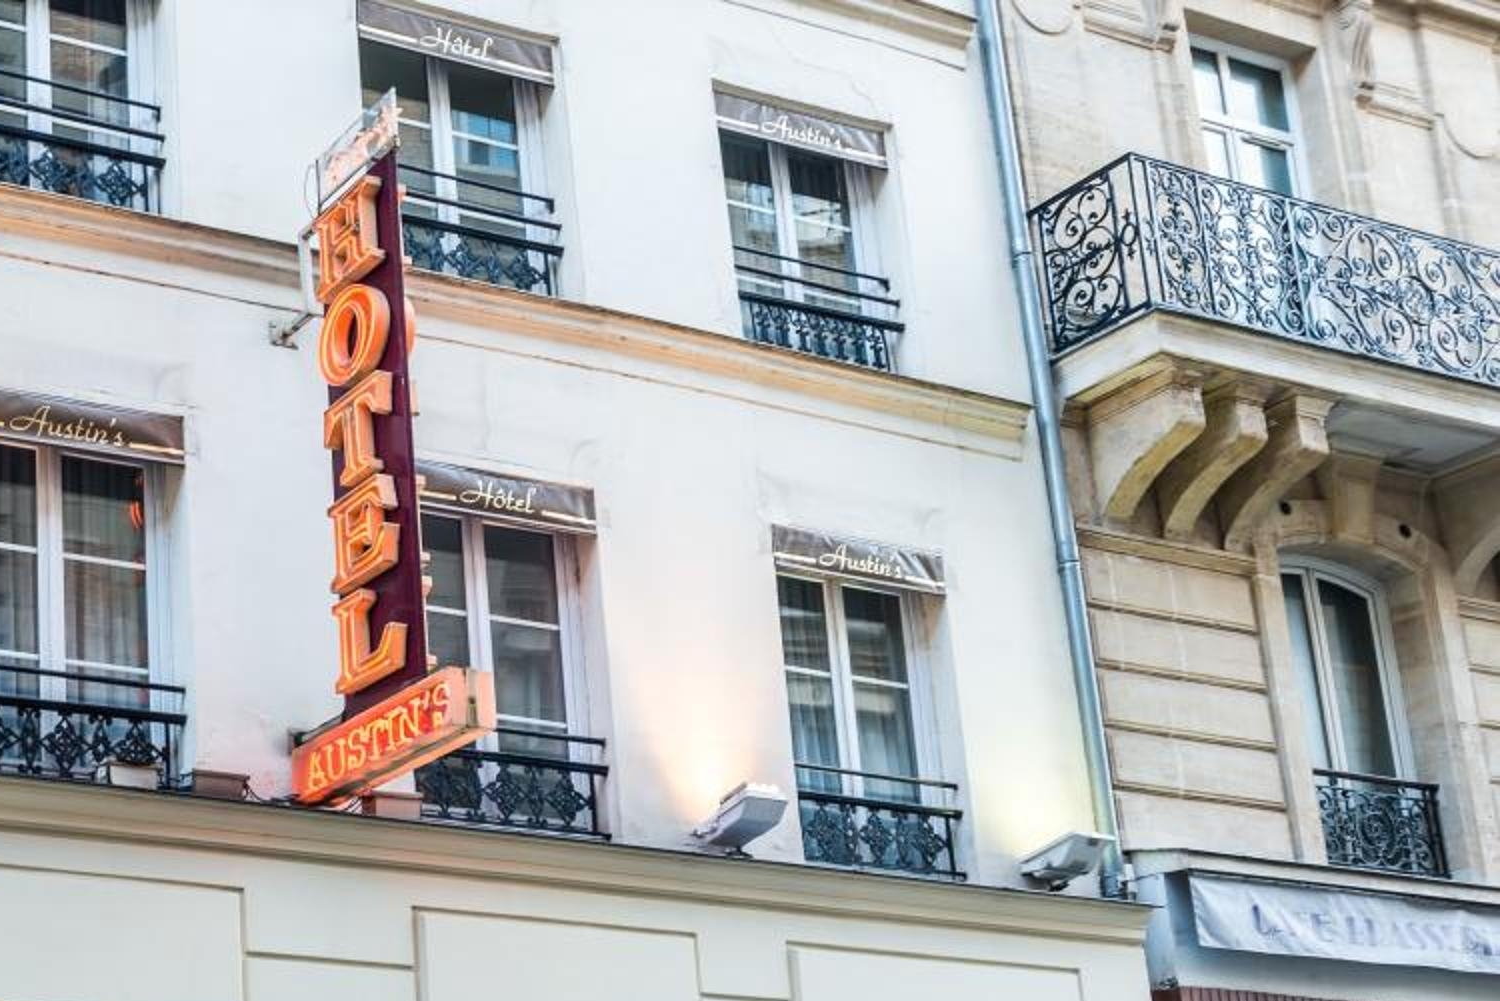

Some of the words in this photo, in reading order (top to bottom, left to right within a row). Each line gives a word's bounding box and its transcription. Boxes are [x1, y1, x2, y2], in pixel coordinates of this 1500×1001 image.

[9, 404, 124, 447] Austin's
[312, 174, 408, 695] HOTEL
[459, 479, 537, 514] Hôtel
[819, 544, 901, 577] Austin's
[307, 682, 450, 792] AUSTIN'S
